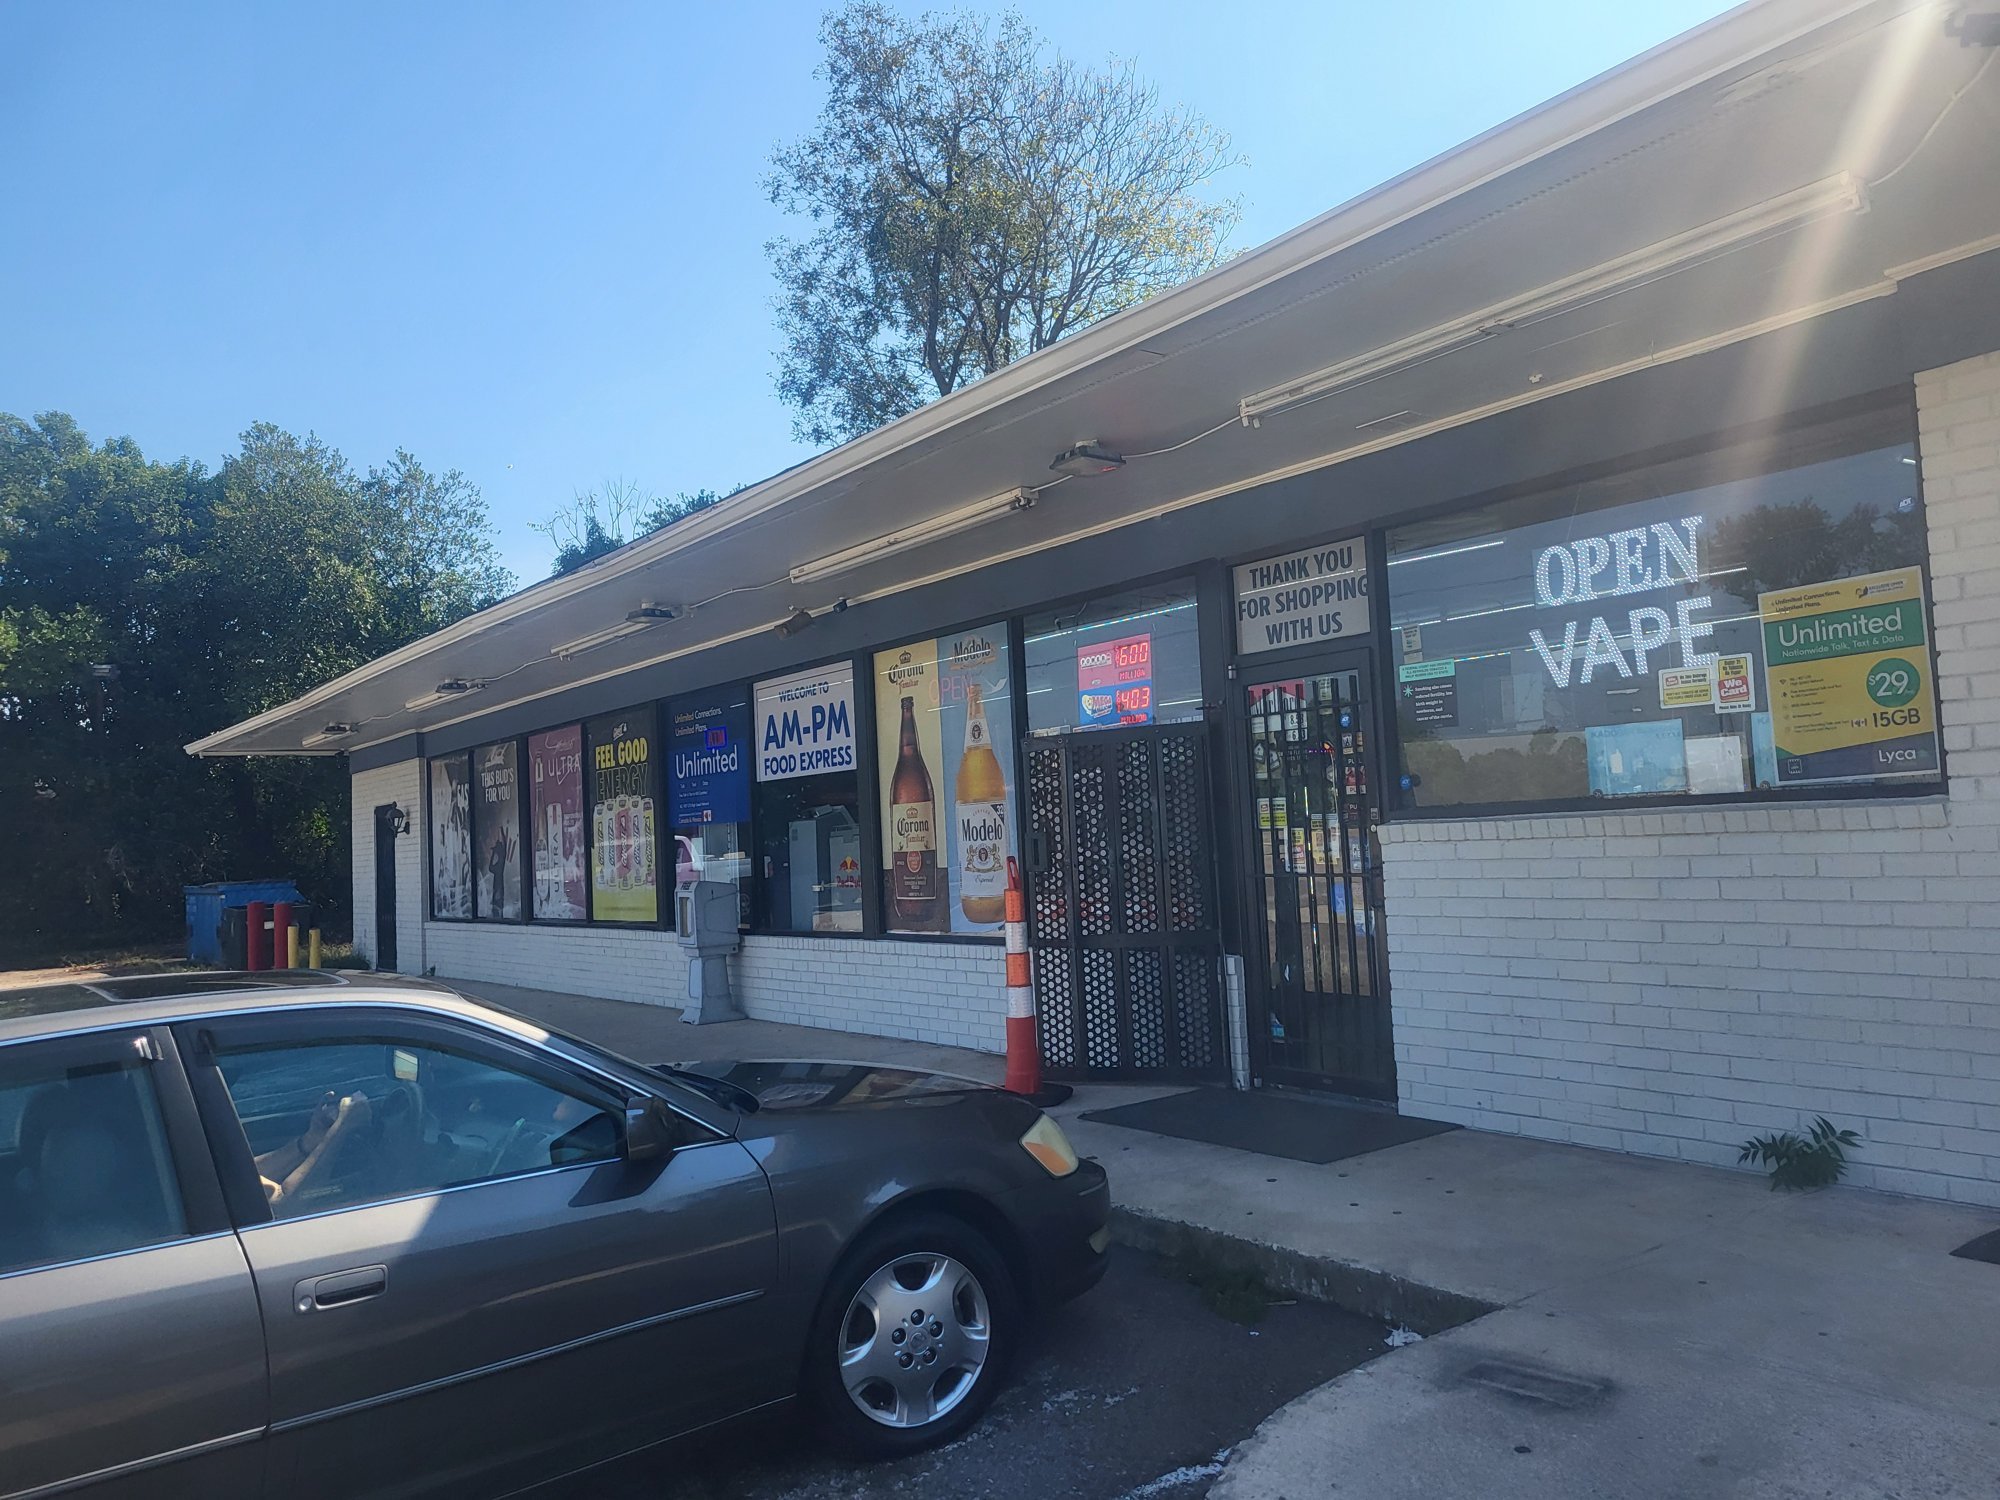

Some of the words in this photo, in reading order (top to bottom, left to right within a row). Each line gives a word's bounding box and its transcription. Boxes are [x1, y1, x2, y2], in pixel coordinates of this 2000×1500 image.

[1249, 557, 1310, 589] THANK
[1314, 546, 1353, 575] YOU
[1536, 515, 1703, 607] OPEN
[1238, 596, 1271, 621] FOR
[1275, 574, 1368, 614] SHOPPING
[1775, 595, 1803, 606] Unlimited
[1775, 604, 1803, 613] Unlimited
[1266, 617, 1313, 645] WITH
[1318, 611, 1343, 636] US
[1778, 607, 1903, 647] Unlimited
[953, 637, 991, 664] Modelo
[1119, 642, 1149, 666] 600
[1528, 596, 1720, 689] VAPE
[1782, 645, 1830, 658] Nationwide
[1831, 641, 1850, 651] Talk,
[1852, 639, 1870, 648] Text
[1872, 637, 1880, 645] &
[1882, 634, 1905, 644] Data
[888, 662, 925, 684] Corona
[1119, 669, 1147, 680] MILLION
[1724, 678, 1742, 688] We
[1868, 670, 1909, 697] $29
[778, 683, 817, 703] WELCOME
[818, 681, 830, 694] TO
[1121, 687, 1151, 710] 403
[1720, 685, 1748, 697] Card
[674, 713, 694, 724] Unlimited
[695, 706, 722, 719] Connections.
[763, 700, 851, 752] AM-PM
[1872, 707, 1921, 728] 15GB
[675, 725, 695, 737] Unlimited
[595, 743, 616, 770] FEEL
[618, 737, 648, 766] GOOD
[675, 744, 738, 779] Unlimited
[764, 754, 797, 776] FOOD
[800, 745, 853, 772] EXPRESS
[1878, 748, 1917, 764] Lyca
[481, 771, 495, 788] THIS
[495, 767, 514, 785] BUD'S
[548, 754, 582, 778] ULTRA
[485, 787, 499, 803] FOR
[498, 784, 511, 801] YOU
[596, 763, 648, 801] ENERGY
[996, 805, 1004, 815] 32
[897, 817, 930, 837] Corona
[962, 817, 1003, 842] Modelo
